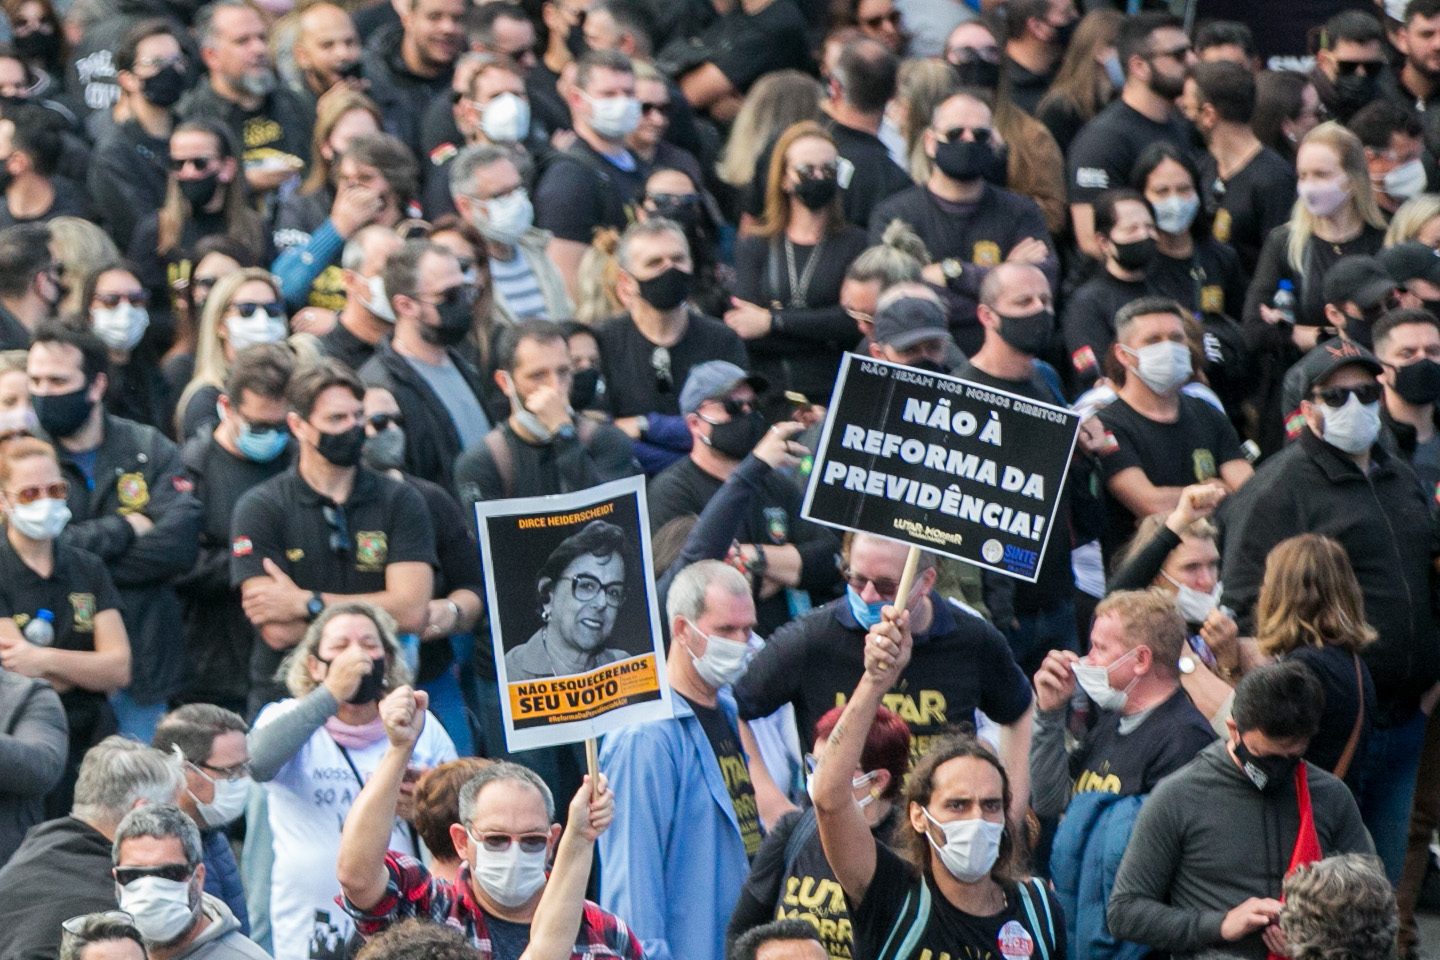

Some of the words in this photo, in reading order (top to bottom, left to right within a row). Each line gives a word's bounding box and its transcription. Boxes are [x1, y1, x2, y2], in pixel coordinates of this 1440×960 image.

[902, 397, 978, 437] NÃO
[979, 410, 1003, 447] À
[841, 423, 998, 487] REFORMA
[1001, 465, 1045, 501] DA
[518, 516, 546, 529] DIRCE
[547, 502, 615, 527] HEIDERSCHEIDT
[823, 460, 1046, 542] PREVIDÊNCIA!
[518, 682, 548, 697] NÃO
[551, 659, 648, 692] ESQUECEREMOS
[519, 694, 560, 713] SEU
[566, 680, 618, 708] VOTO
